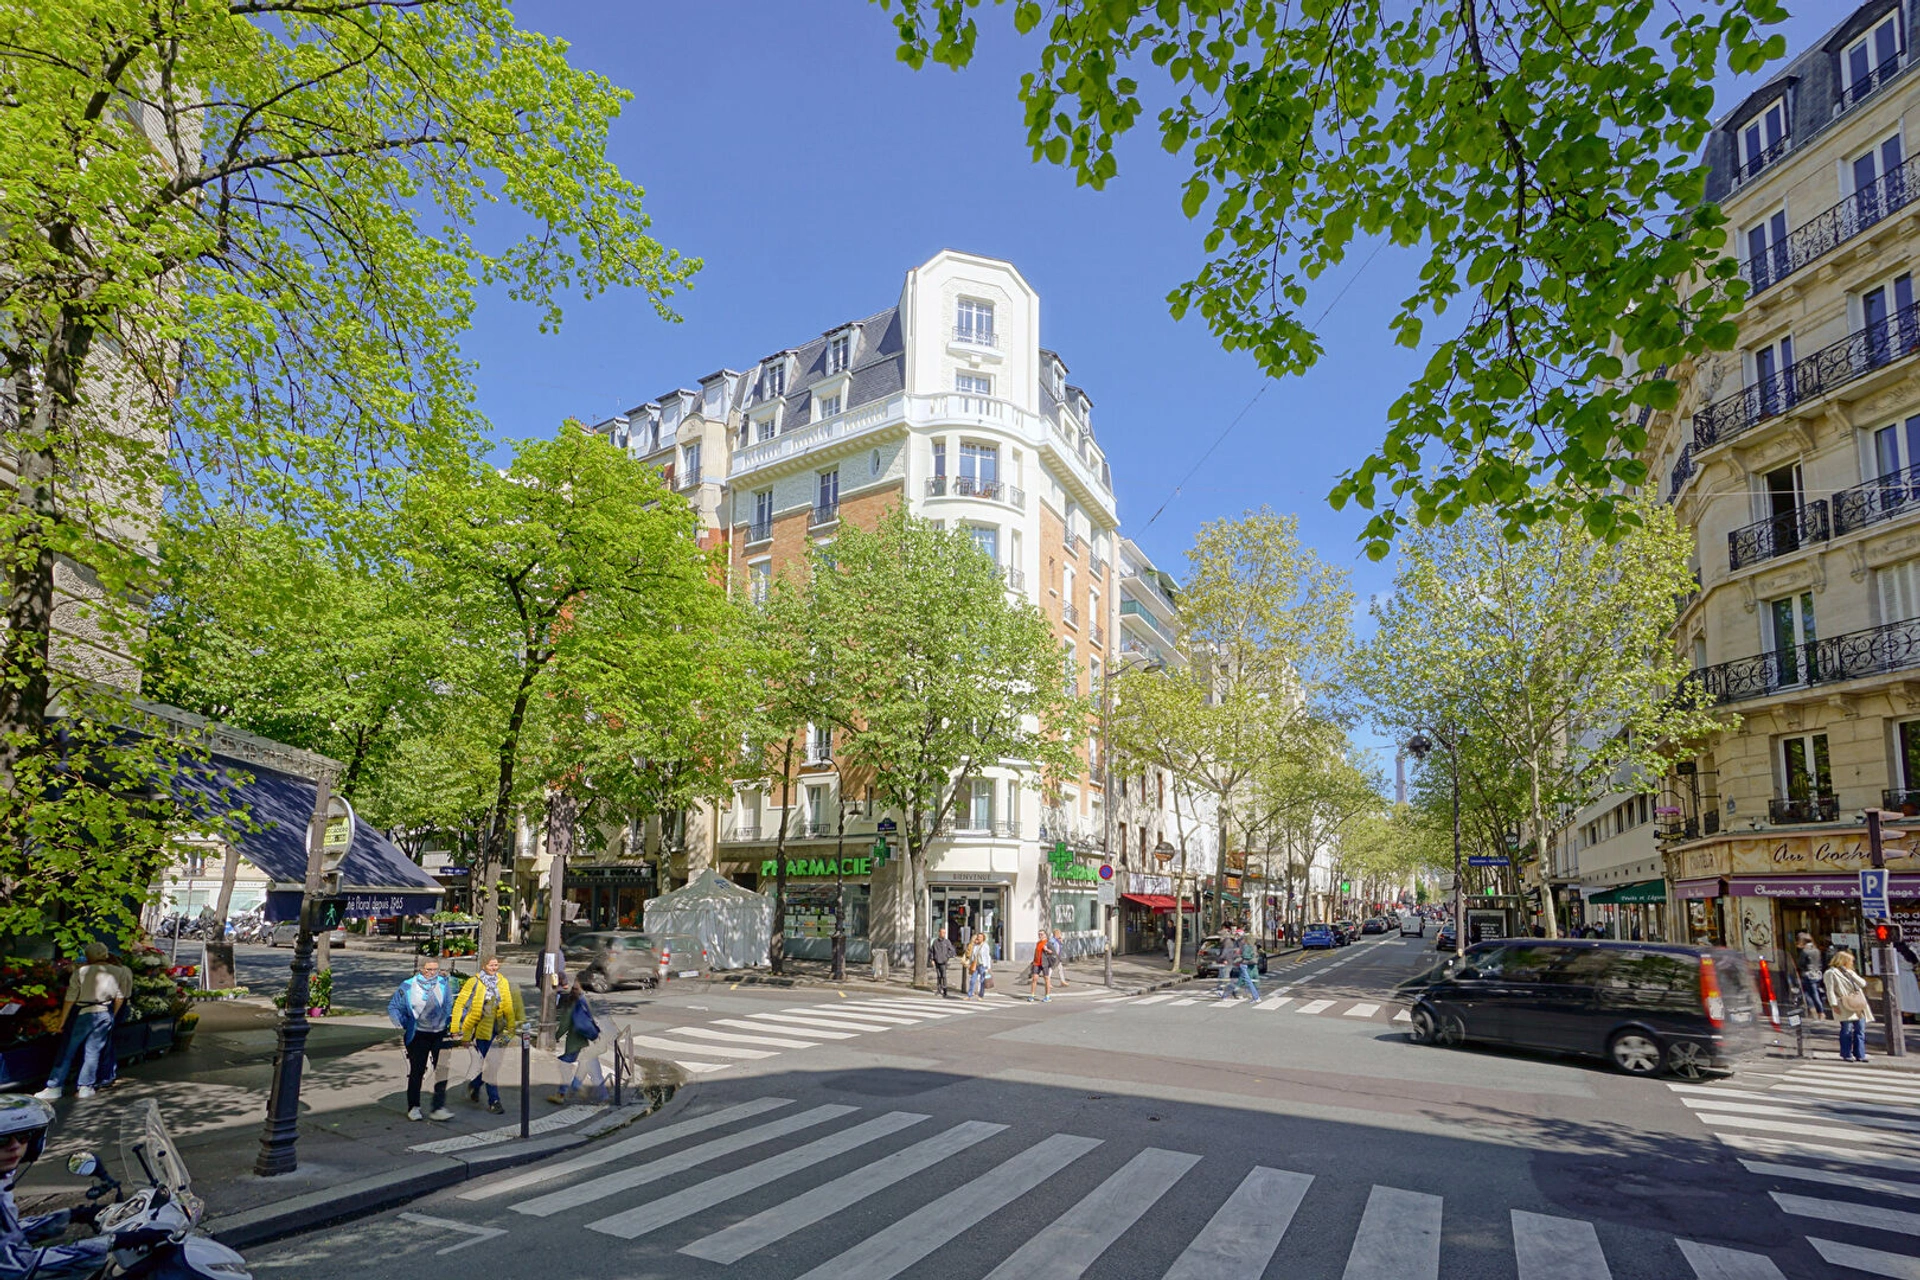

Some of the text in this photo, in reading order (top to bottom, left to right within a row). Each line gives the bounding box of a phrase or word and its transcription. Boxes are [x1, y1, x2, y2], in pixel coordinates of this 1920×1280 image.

[1773, 843, 1804, 862] Au
[1816, 842, 1871, 861] Coch
[1754, 885, 1796, 897] Champion
[1800, 887, 1809, 896] de
[1812, 885, 1846, 896] France
[1866, 875, 1878, 894] P
